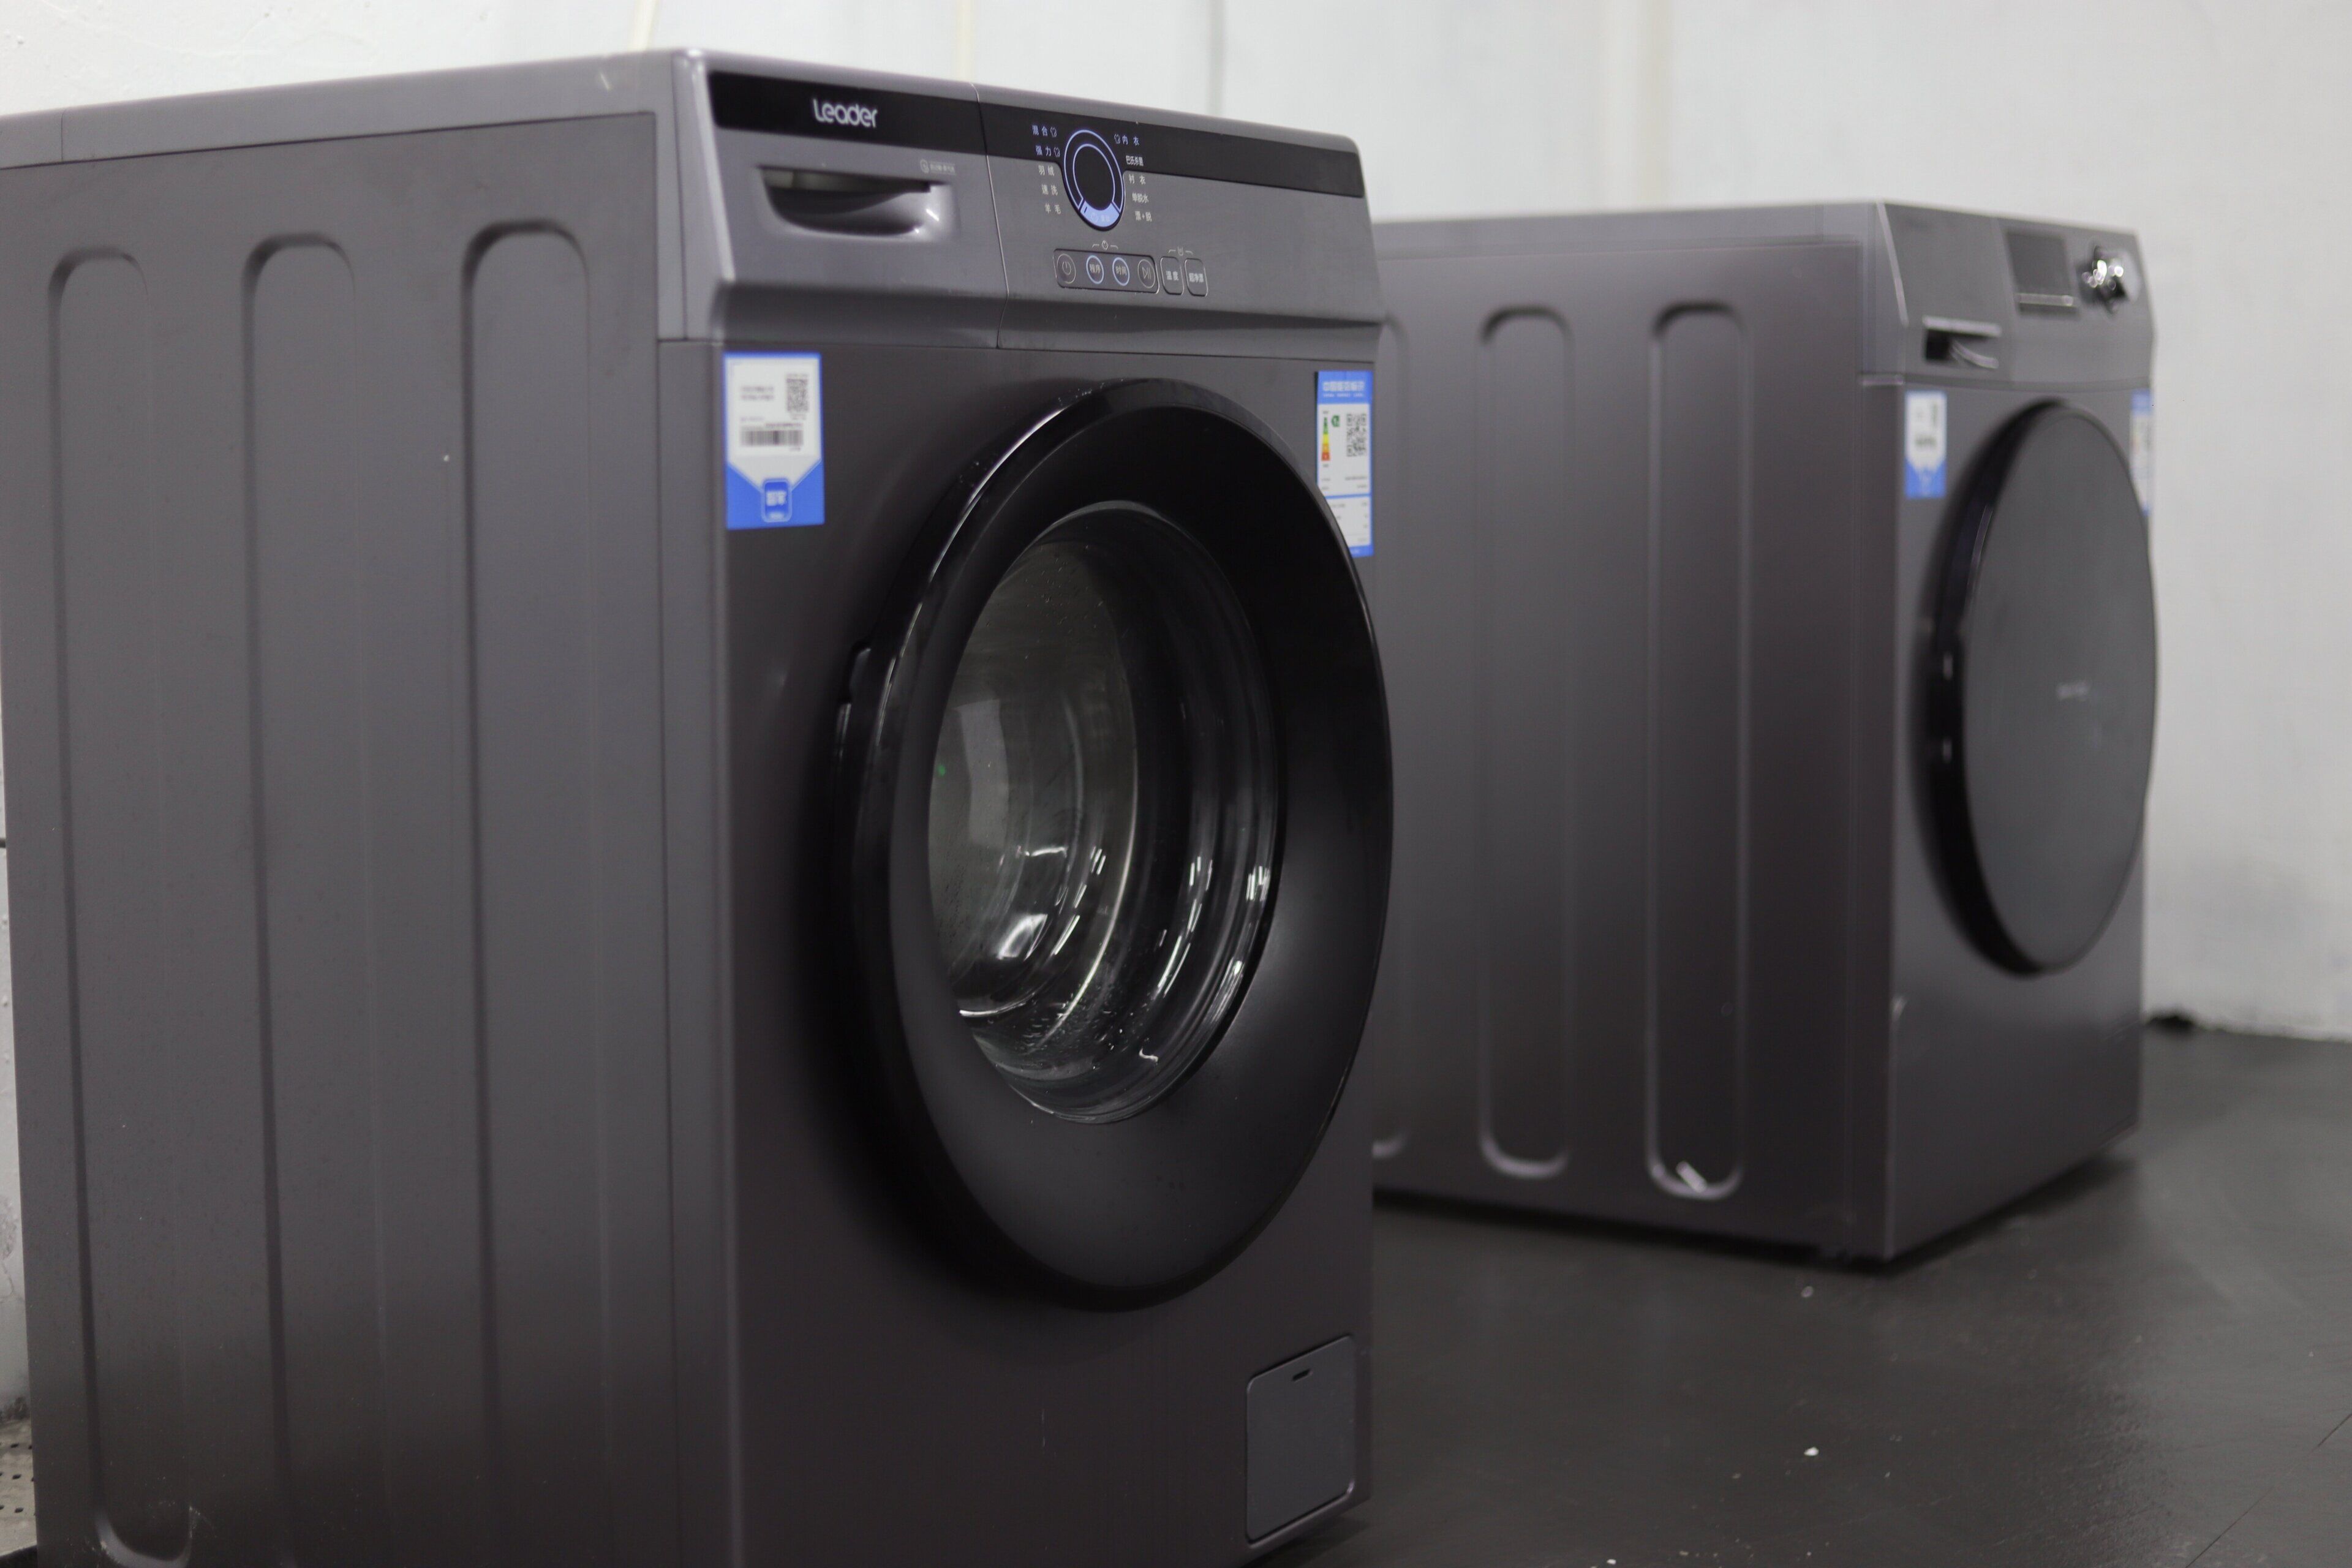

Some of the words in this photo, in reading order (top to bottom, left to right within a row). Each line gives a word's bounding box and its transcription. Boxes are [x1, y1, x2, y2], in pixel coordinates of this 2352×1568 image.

[813, 98, 878, 128] Leader
[1032, 125, 1048, 136] 混合
[1122, 135, 1140, 146] 内衣
[1035, 145, 1052, 156] 强力
[1125, 155, 1144, 167] 巴氏杀菌
[1038, 165, 1055, 176] 羽绒
[1041, 184, 1058, 196] 速洗
[1132, 192, 1149, 203] 单脱水
[1044, 203, 1061, 214] 羊毛
[1089, 263, 1101, 273] 程序
[1115, 265, 1128, 276] 时间
[1166, 271, 1179, 281] 温度
